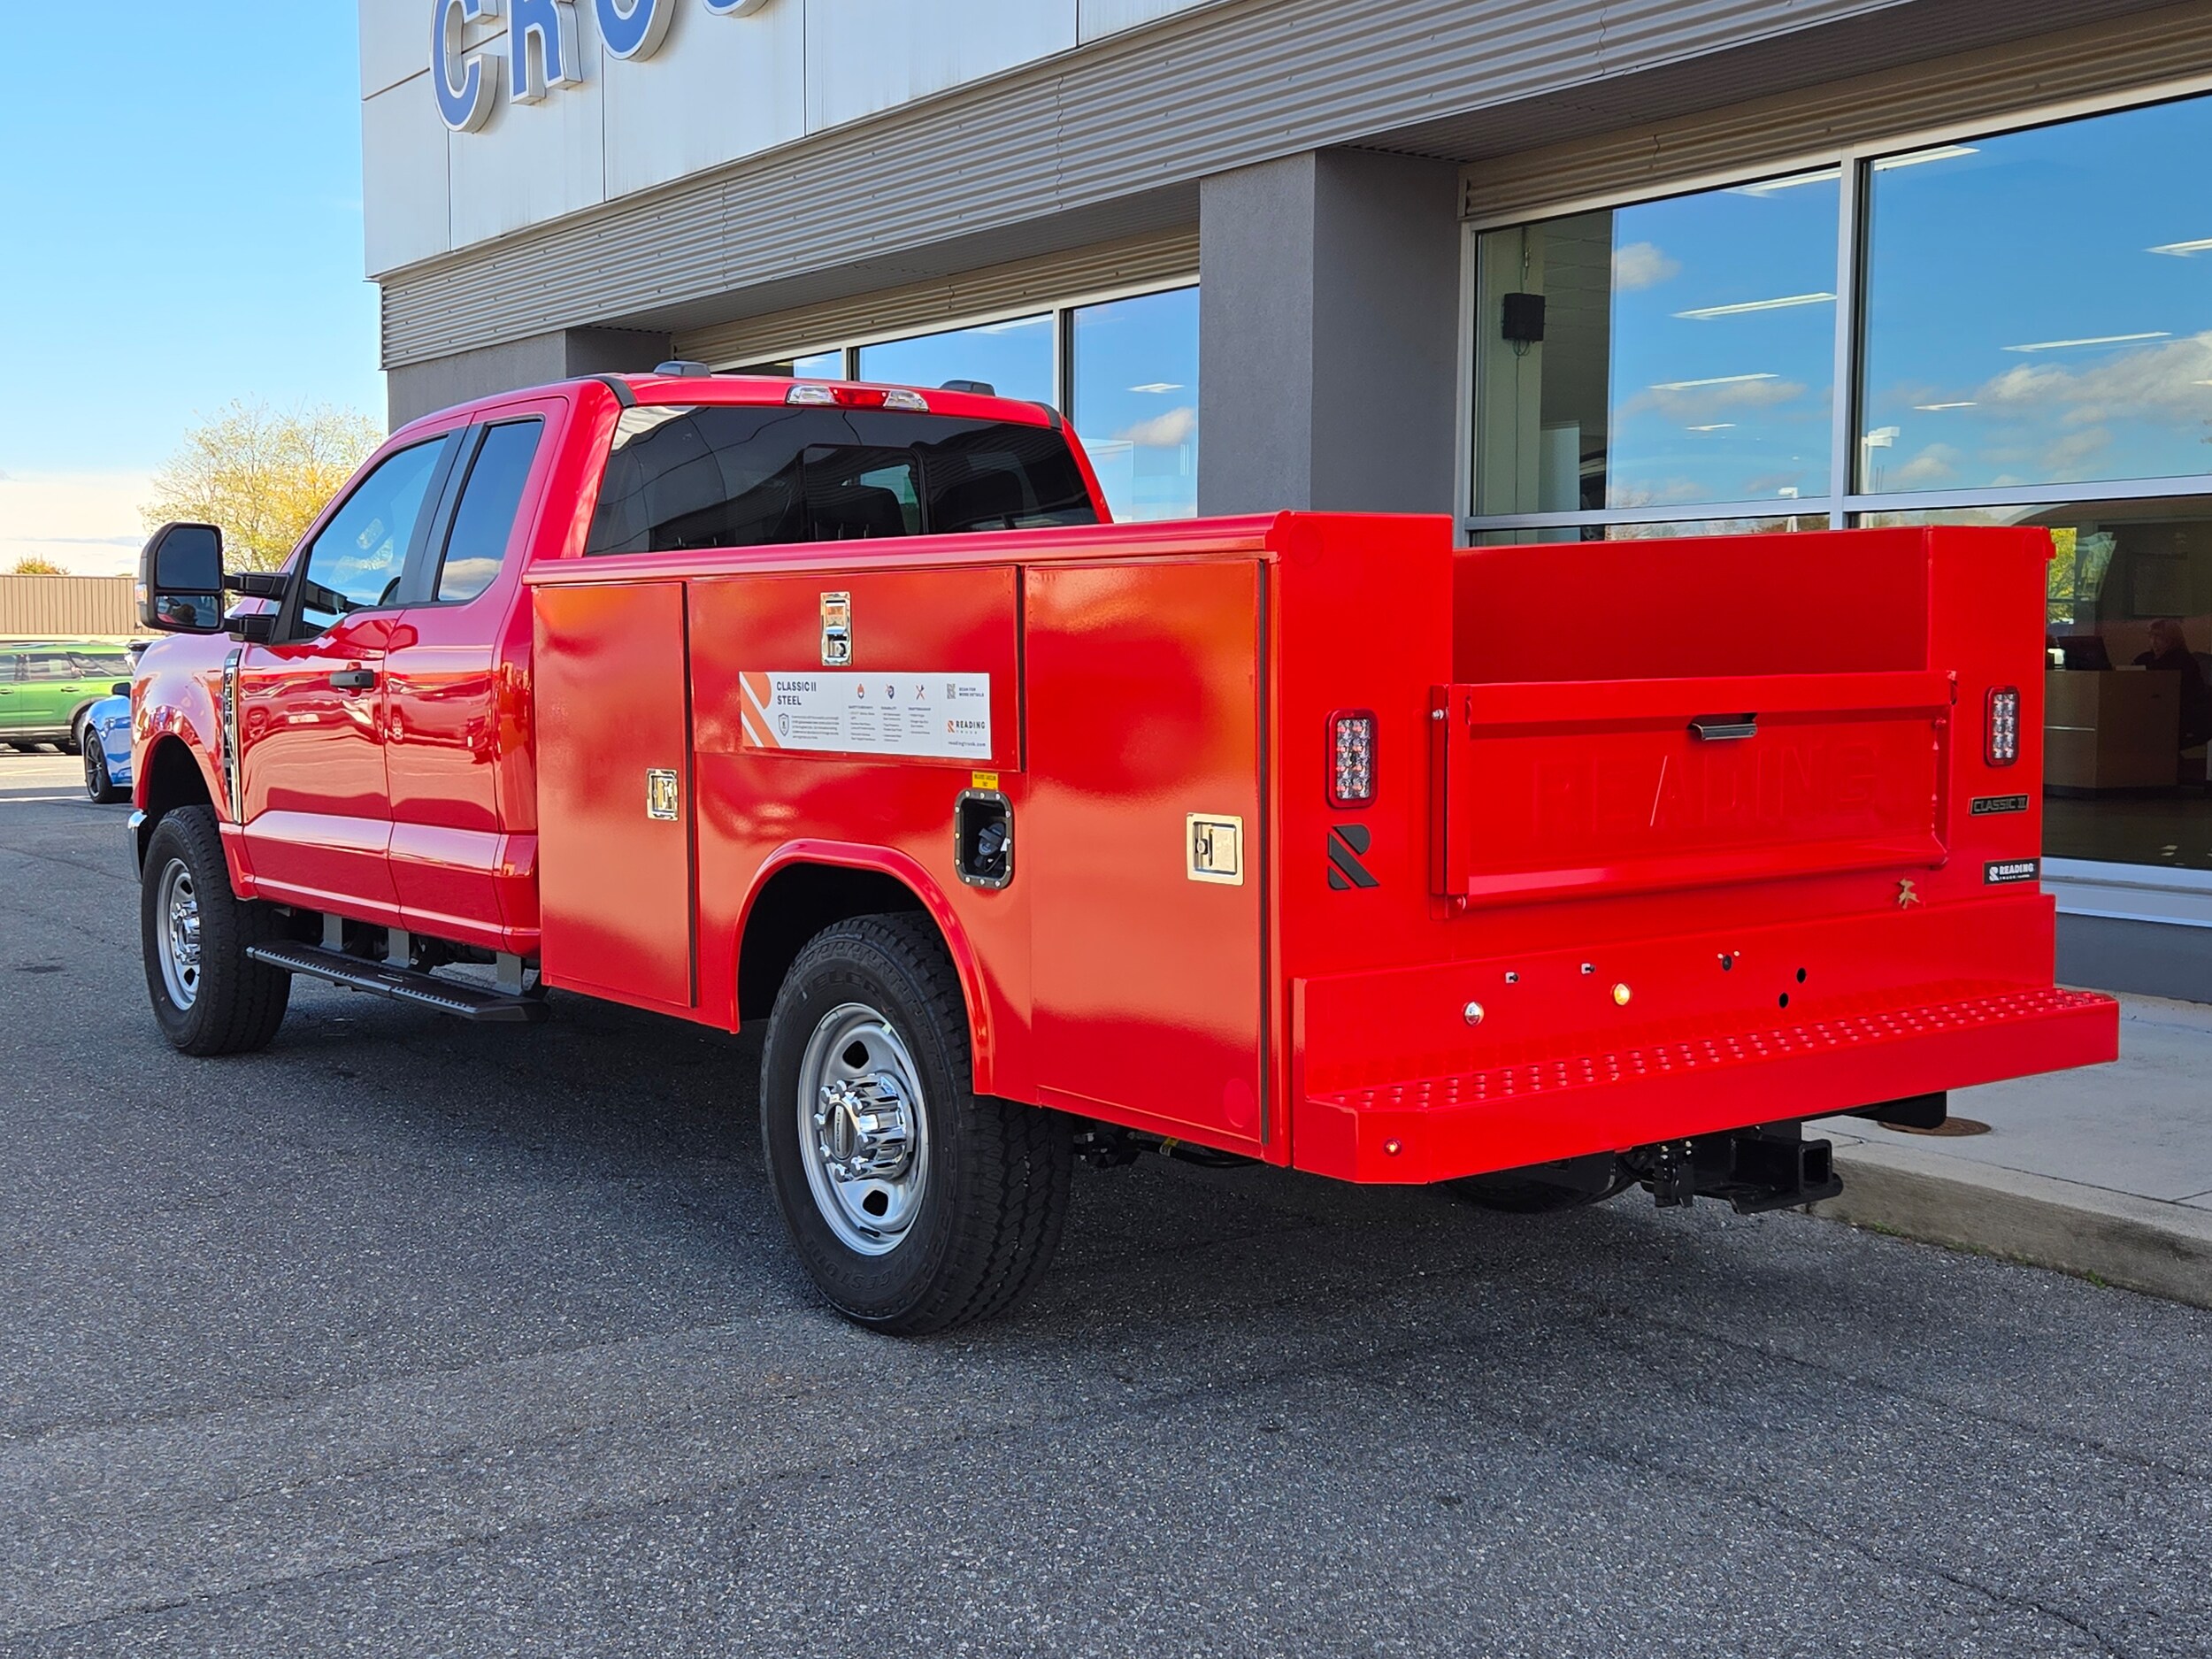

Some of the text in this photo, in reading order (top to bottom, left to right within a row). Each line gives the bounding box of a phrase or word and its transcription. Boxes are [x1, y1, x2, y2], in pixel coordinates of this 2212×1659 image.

[776, 680, 810, 692] CLASSIC
[777, 695, 803, 706] STEEL
[956, 720, 986, 730] READING
[1974, 798, 2016, 812] CLASSIC
[1999, 863, 2034, 875] READING
